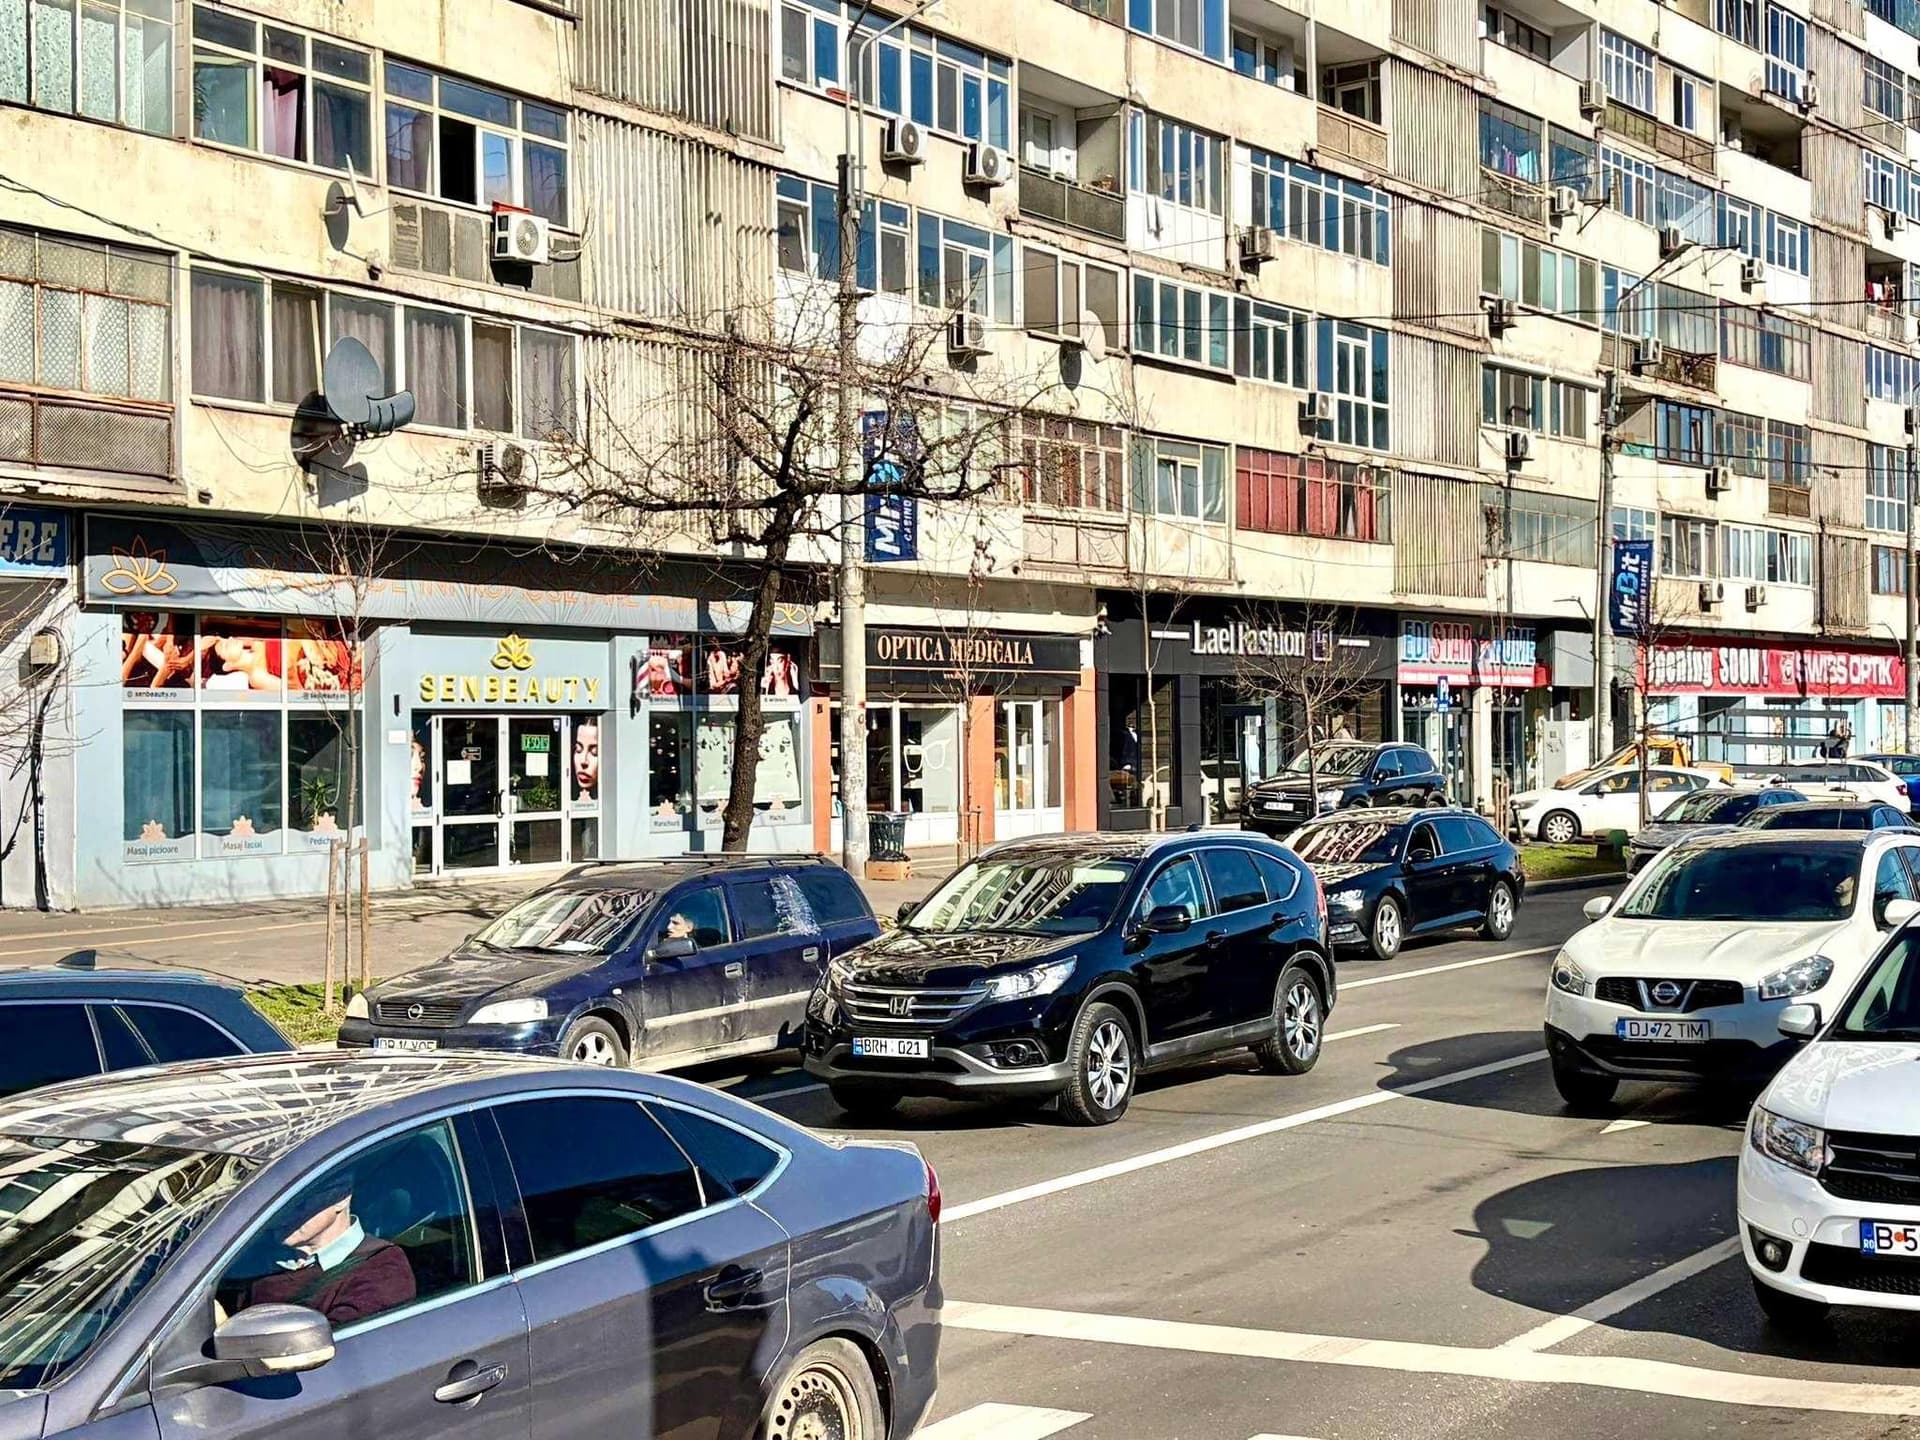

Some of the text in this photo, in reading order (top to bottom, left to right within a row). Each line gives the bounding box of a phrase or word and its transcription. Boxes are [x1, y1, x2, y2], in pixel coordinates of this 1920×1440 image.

[903, 499, 914, 542] CASINO
[877, 635, 1034, 665] OPTICA MEDICALA
[1193, 620, 1306, 657] Lael Fashion
[1431, 621, 1472, 663] STAR
[1849, 655, 1893, 686] OPTIK
[420, 675, 600, 703] SENBEAUTY
[1629, 1022, 1704, 1038] DJ 72 TIM
[864, 1039, 921, 1055] BRH 021
[1876, 1226, 1893, 1250] B
